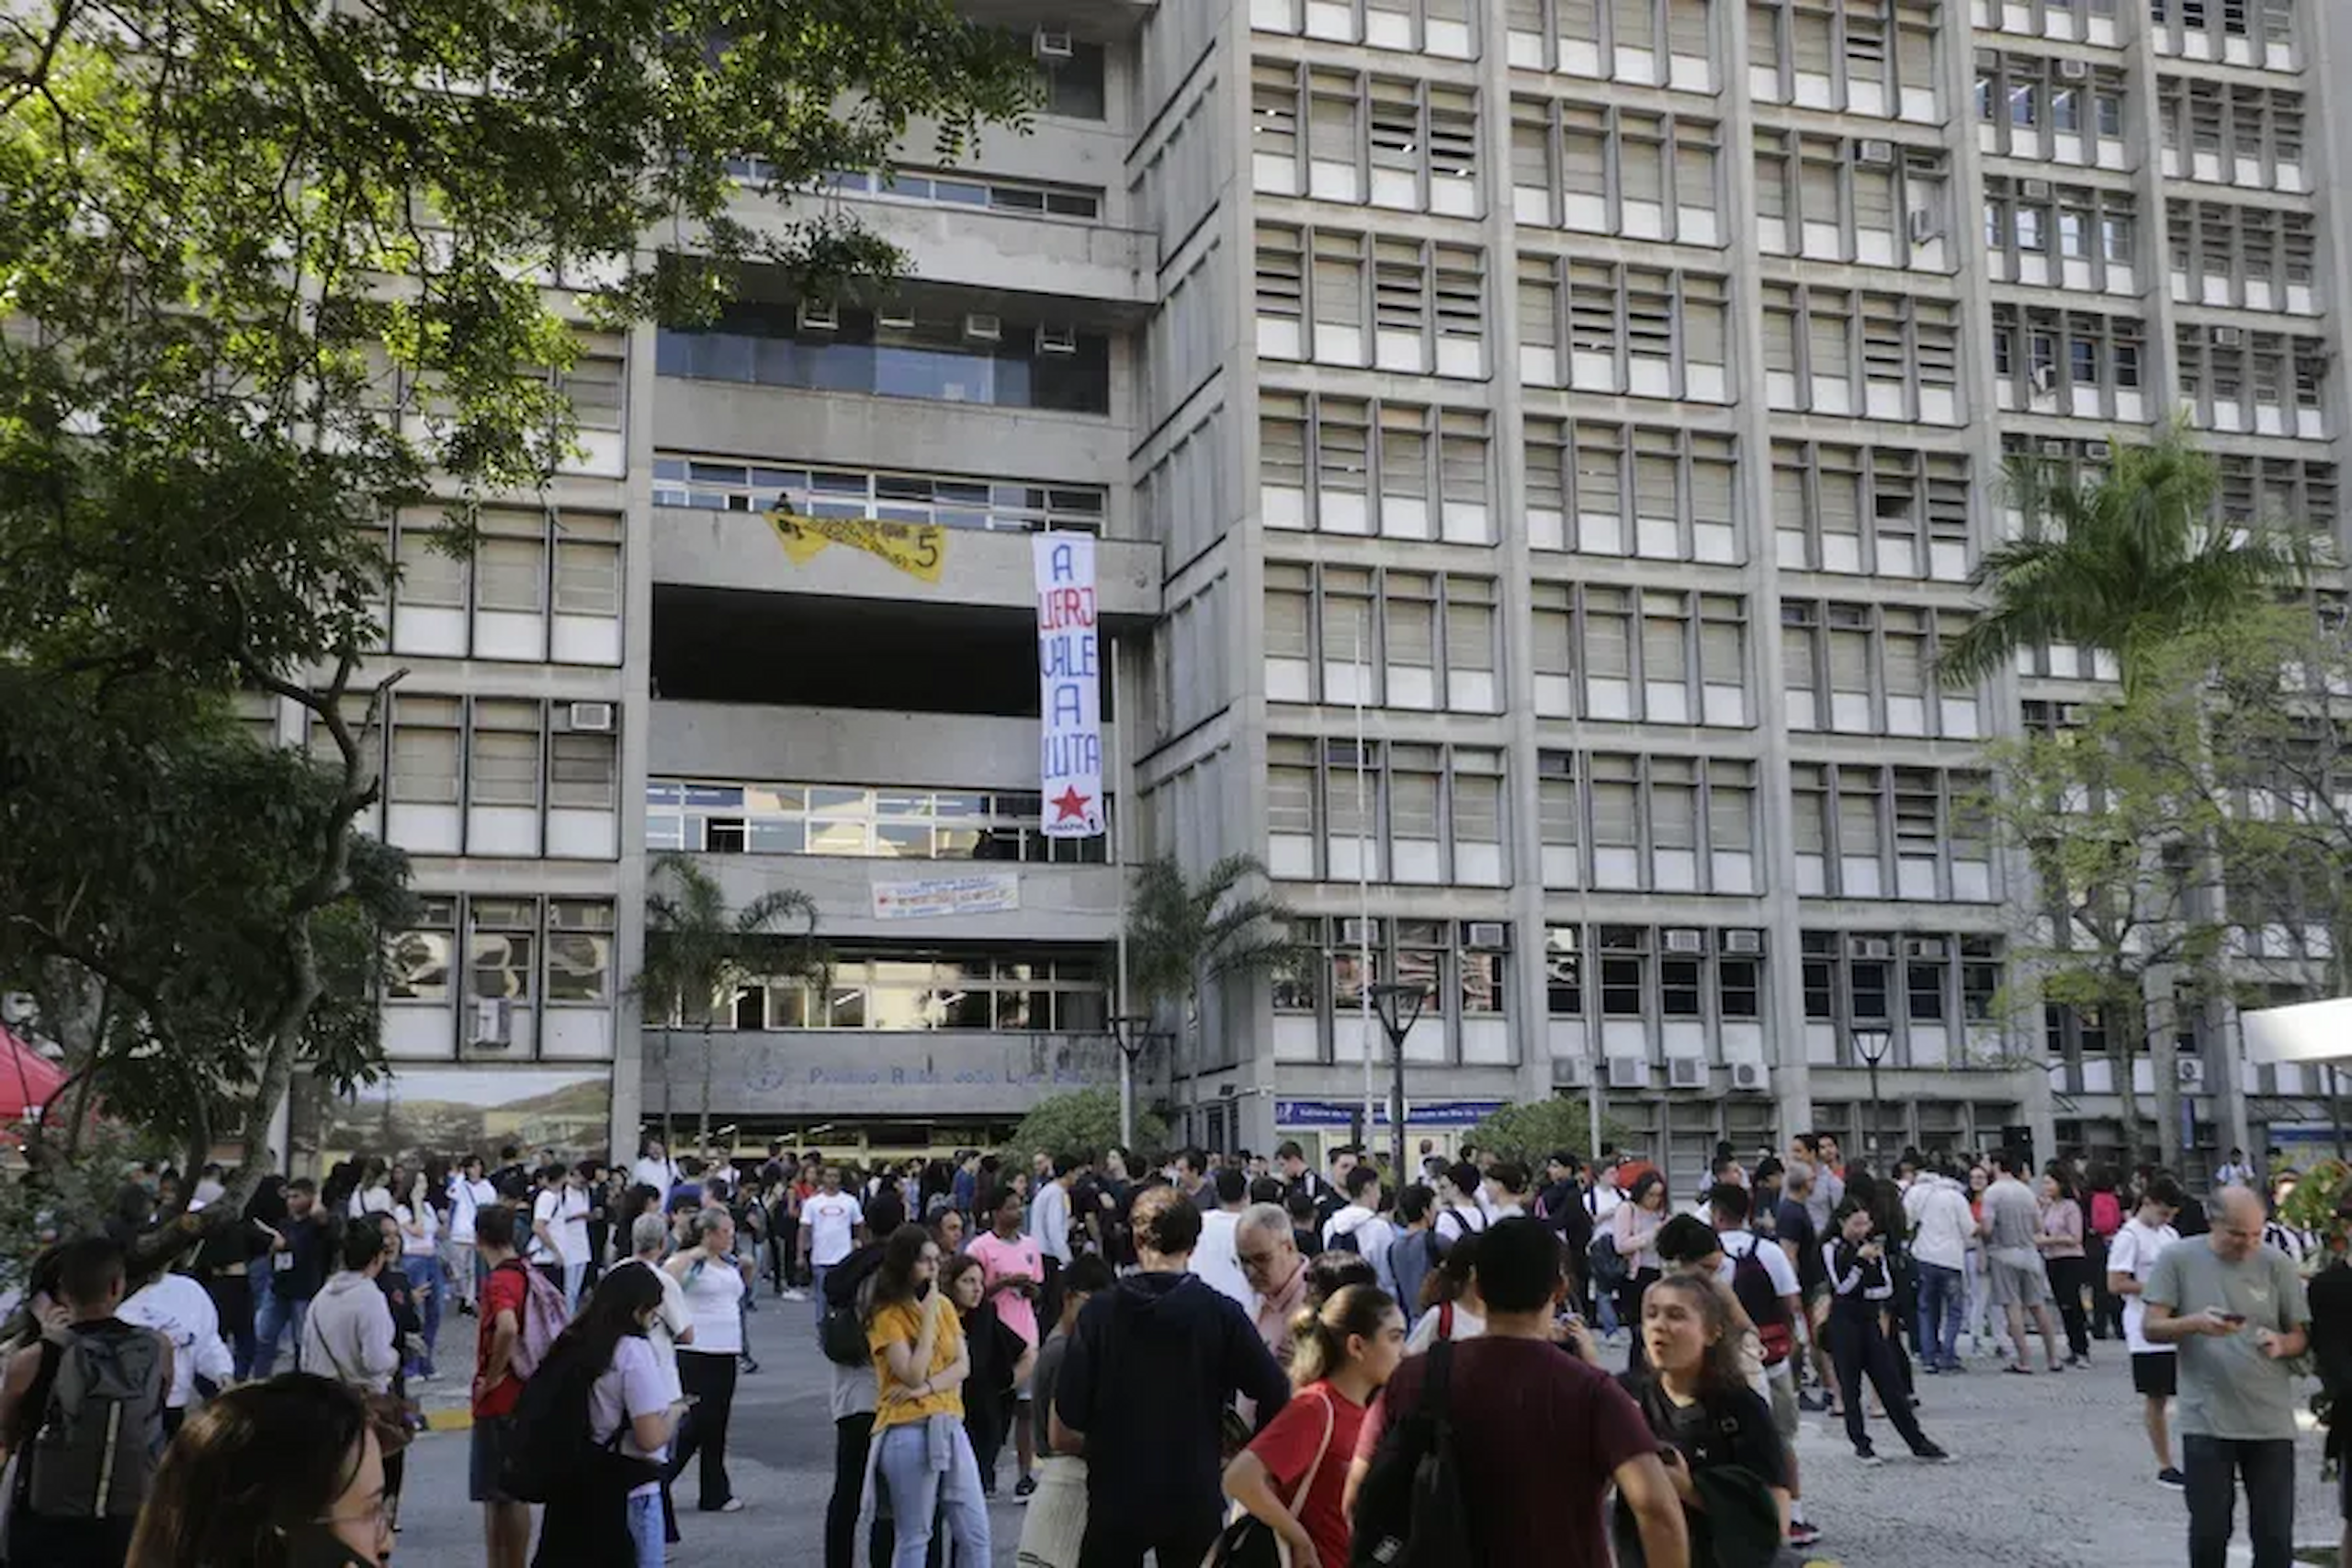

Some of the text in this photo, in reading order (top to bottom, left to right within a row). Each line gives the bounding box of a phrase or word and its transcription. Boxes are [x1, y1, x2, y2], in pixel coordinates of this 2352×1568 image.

[914, 534, 938, 568] 5
[1052, 543, 1073, 581] A
[1038, 586, 1094, 629] UERJ
[1040, 635, 1095, 677] VALE
[1054, 683, 1080, 727] A
[1045, 733, 1101, 779] LUTA
